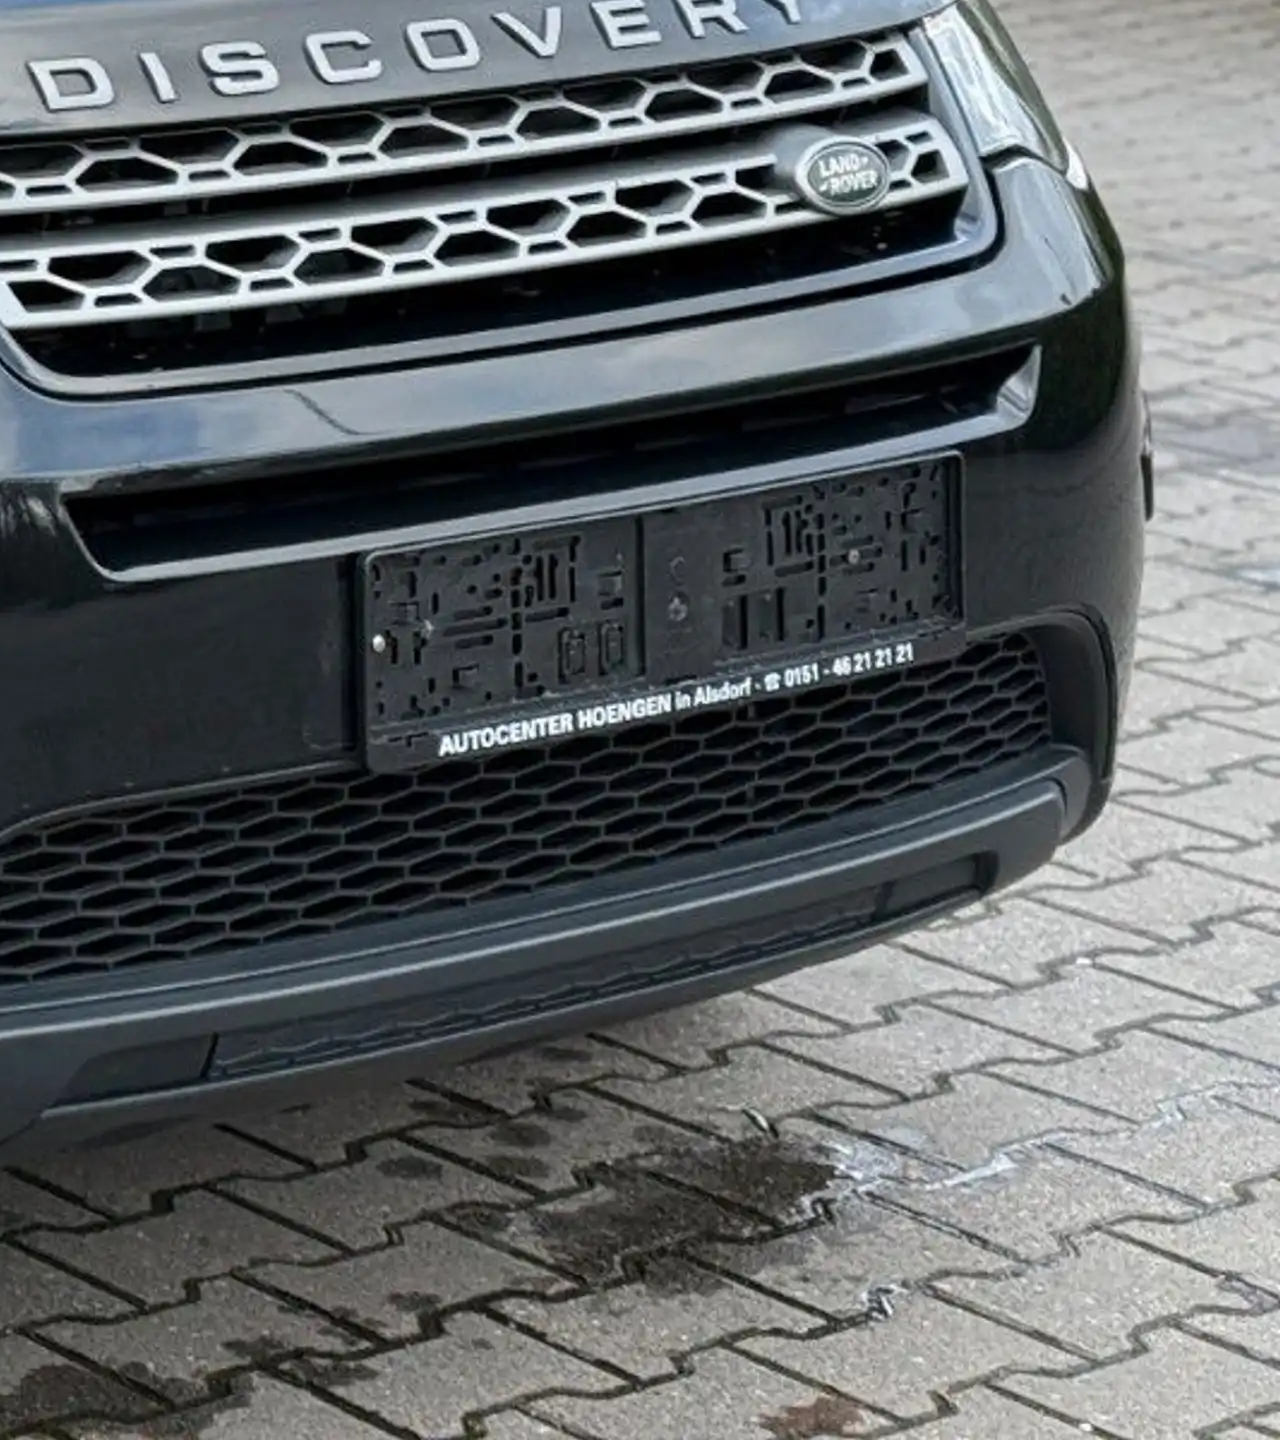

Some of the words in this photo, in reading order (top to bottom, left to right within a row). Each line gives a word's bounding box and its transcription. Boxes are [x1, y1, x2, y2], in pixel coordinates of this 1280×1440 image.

[818, 153, 859, 178] LAND
[831, 169, 878, 196] ROVER
[438, 713, 573, 757] AUTOCENTER
[577, 693, 672, 730] HOENGEN
[675, 691, 690, 710] in
[694, 676, 752, 707] Alsdorf
[784, 663, 818, 688] 0151
[853, 652, 871, 673] 21
[875, 647, 892, 668] 21
[896, 642, 914, 662] 21
